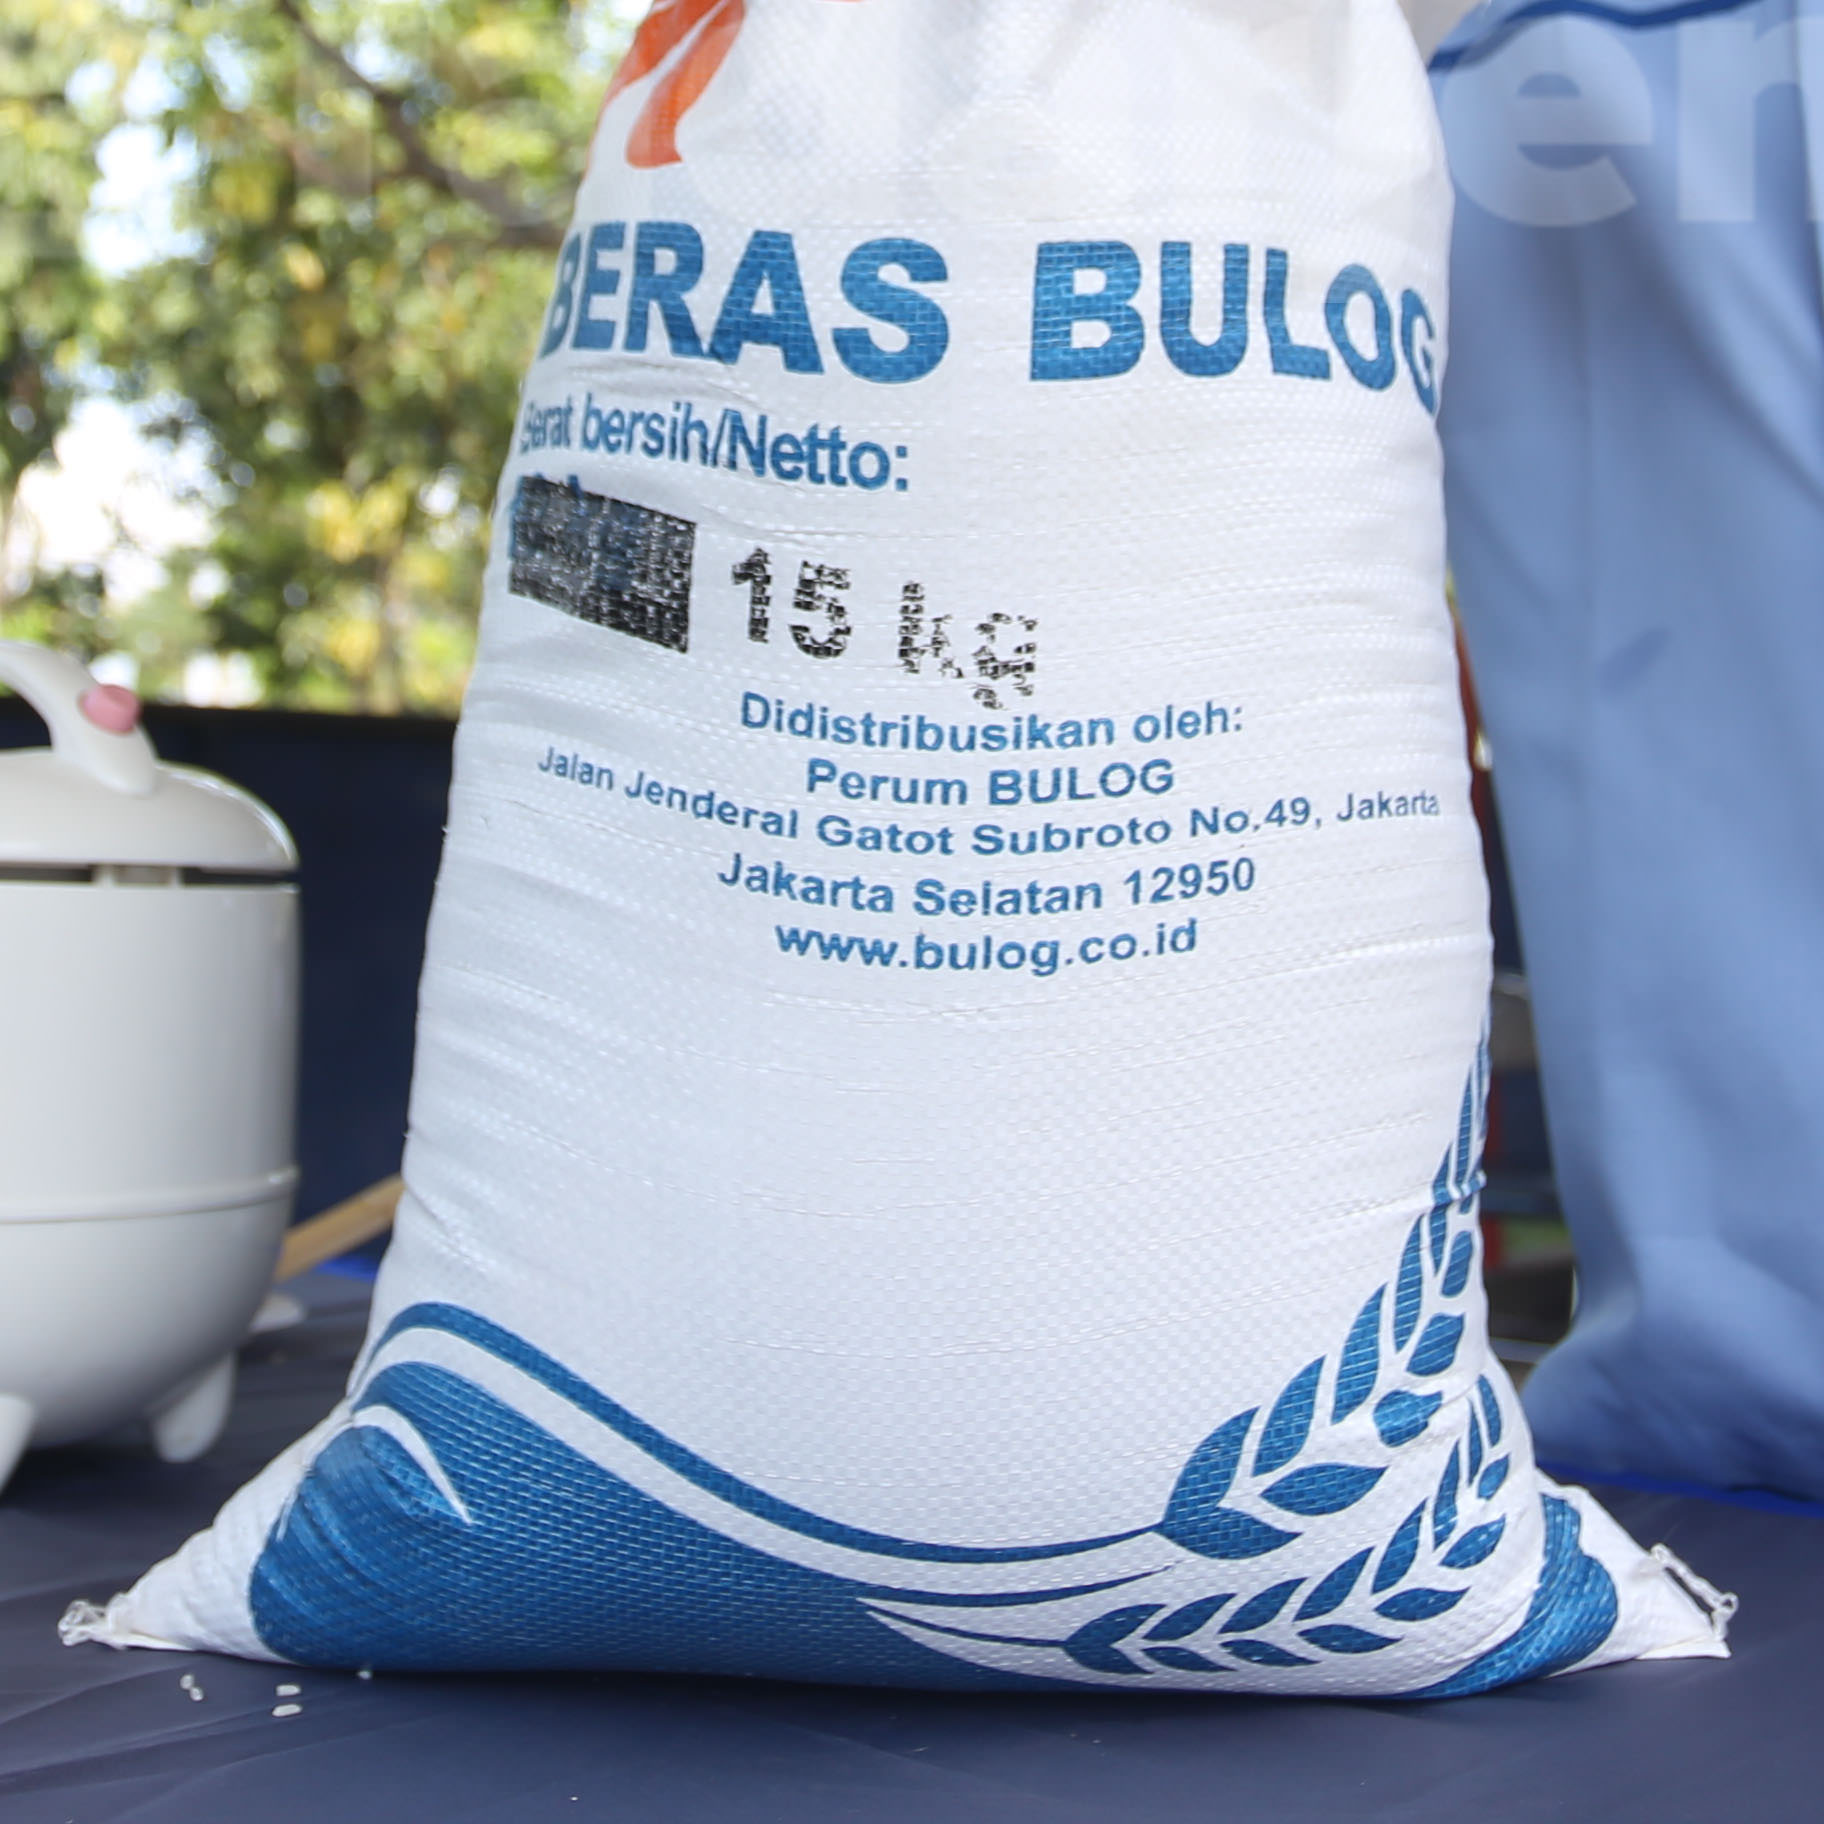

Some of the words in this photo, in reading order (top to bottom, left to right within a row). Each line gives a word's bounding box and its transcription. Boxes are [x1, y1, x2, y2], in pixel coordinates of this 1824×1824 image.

[539, 220, 950, 384] BERAS
[1029, 240, 1440, 417] BULOG
[581, 394, 908, 492] bersih/Netto:
[731, 546, 852, 659] 15
[740, 690, 1115, 753] Didistribusikan
[1132, 700, 1243, 742] oleh:
[537, 746, 614, 791] Jalan
[624, 771, 798, 840] Jenderal
[816, 814, 954, 856] Gatot
[971, 814, 1172, 856] Subroto
[1189, 796, 1323, 838] No.49,
[1337, 788, 1442, 823] Jakarta
[806, 757, 968, 806] Perum
[988, 757, 1174, 806] BULOG
[717, 851, 895, 914] Jakarta
[913, 876, 1103, 918] Selatan
[1123, 857, 1256, 905] 12950
[775, 917, 1198, 977] www.bulog.co.id
